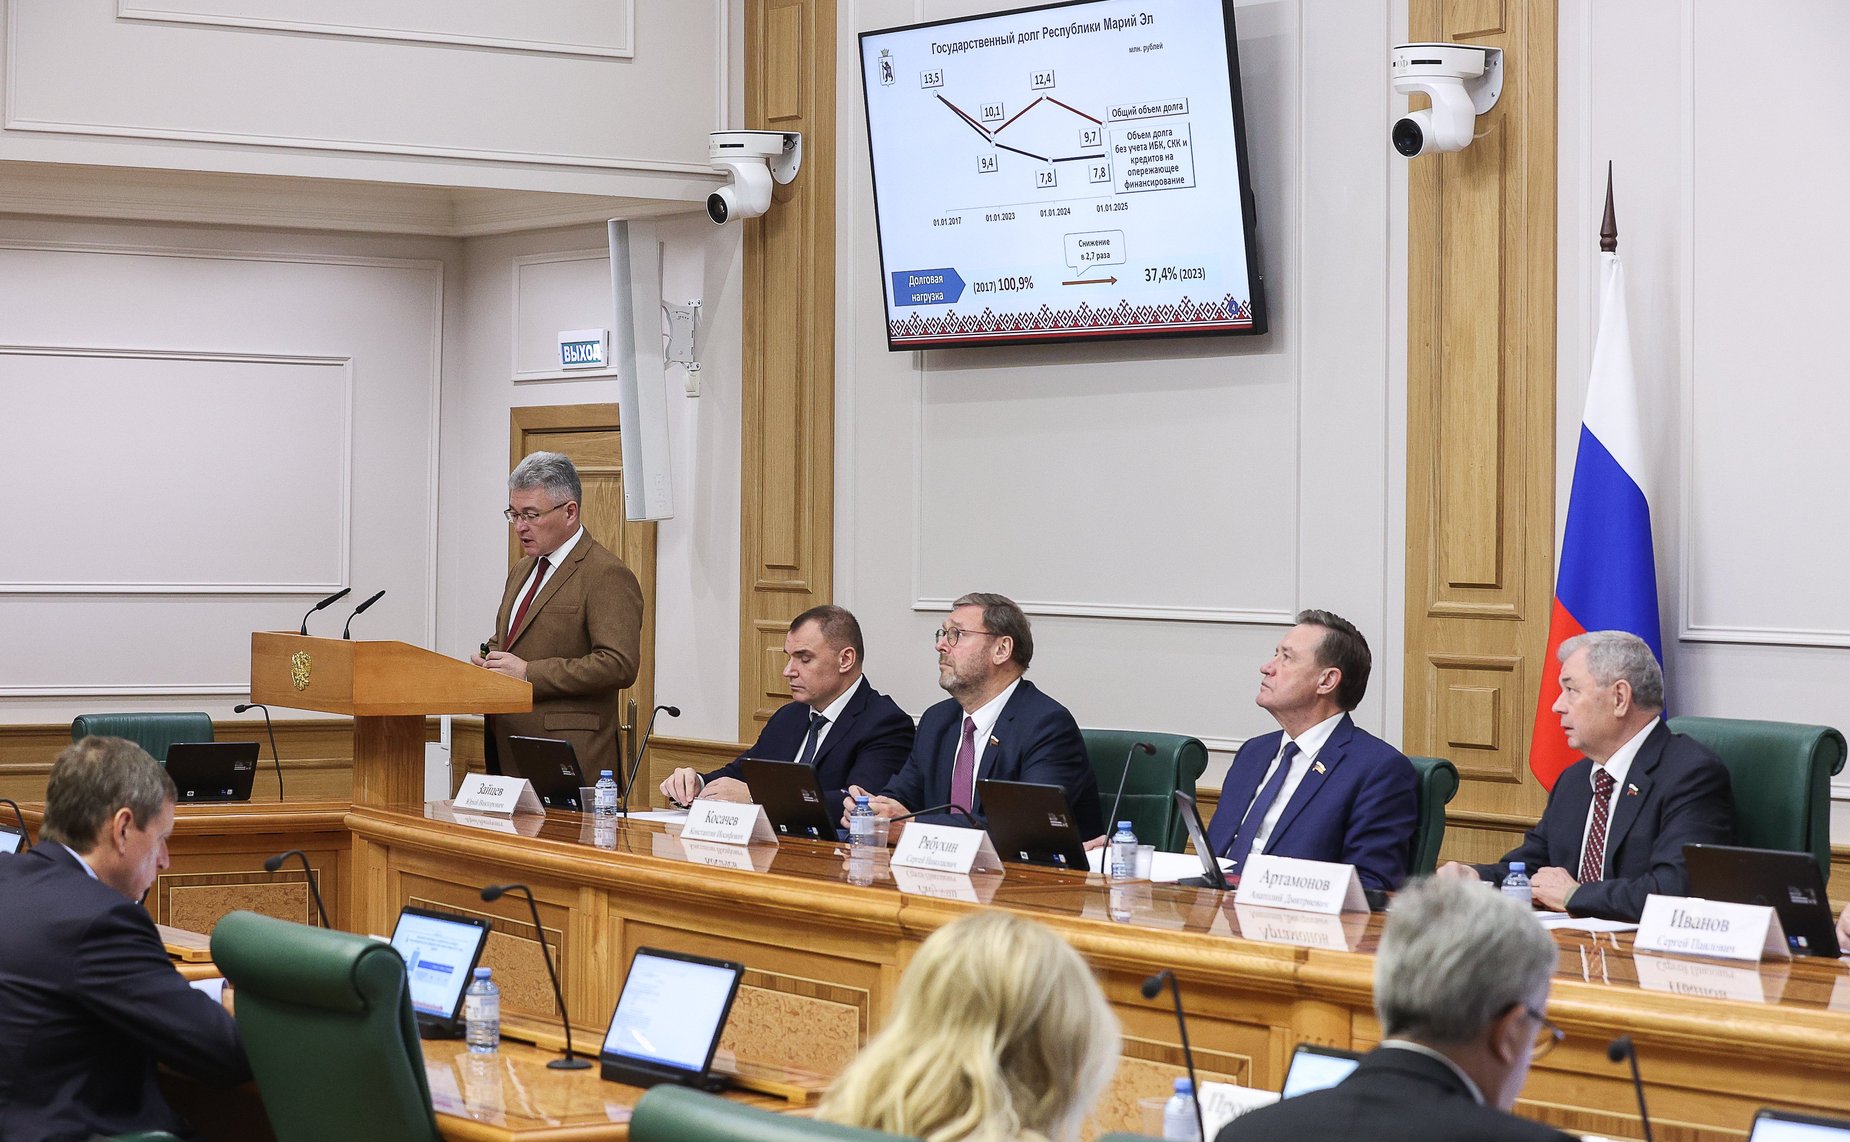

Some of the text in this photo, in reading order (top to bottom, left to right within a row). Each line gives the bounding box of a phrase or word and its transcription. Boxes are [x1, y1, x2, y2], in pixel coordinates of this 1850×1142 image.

[931, 12, 1154, 55] Государственный долг Республики Марий Эл
[1143, 42, 1164, 53] рублей
[924, 72, 940, 84] 13,5
[1034, 73, 1051, 86] 12,4
[984, 105, 1001, 118] 10,1
[1111, 102, 1184, 118] Общий объем долга
[1084, 131, 1096, 144] 9,7
[1127, 129, 1173, 140] Объем долга
[1115, 139, 1188, 154] без учета ИБК, СКК и
[981, 157, 994, 169] 9,4
[1130, 153, 1174, 166] кредитов на
[1093, 166, 1106, 179] 7,8
[1127, 165, 1179, 177] опережающее
[1040, 172, 1053, 184] 7,8
[1124, 176, 1185, 190] финансирование
[1039, 207, 1071, 218] 01.01.2024
[1096, 202, 1129, 213] 01.01.2025
[933, 216, 962, 227] 01.01.2017
[985, 212, 1016, 222] 01.01.2023
[1078, 239, 1111, 247] Снижение
[1086, 251, 1095, 261] 2,7
[1096, 252, 1111, 261] раза
[908, 275, 944, 287] Долговая
[1144, 266, 1206, 283] 37,4% (2023)
[973, 276, 1034, 295] (2017) 100,9%
[911, 291, 944, 304] нагрузка
[563, 343, 602, 362] ВЫХОД
[477, 782, 504, 796] Зайцев
[704, 810, 739, 826] Косачев
[918, 835, 959, 854] Рябухин
[1258, 868, 1331, 891] Артамонов
[1670, 908, 1730, 932] Иванов
